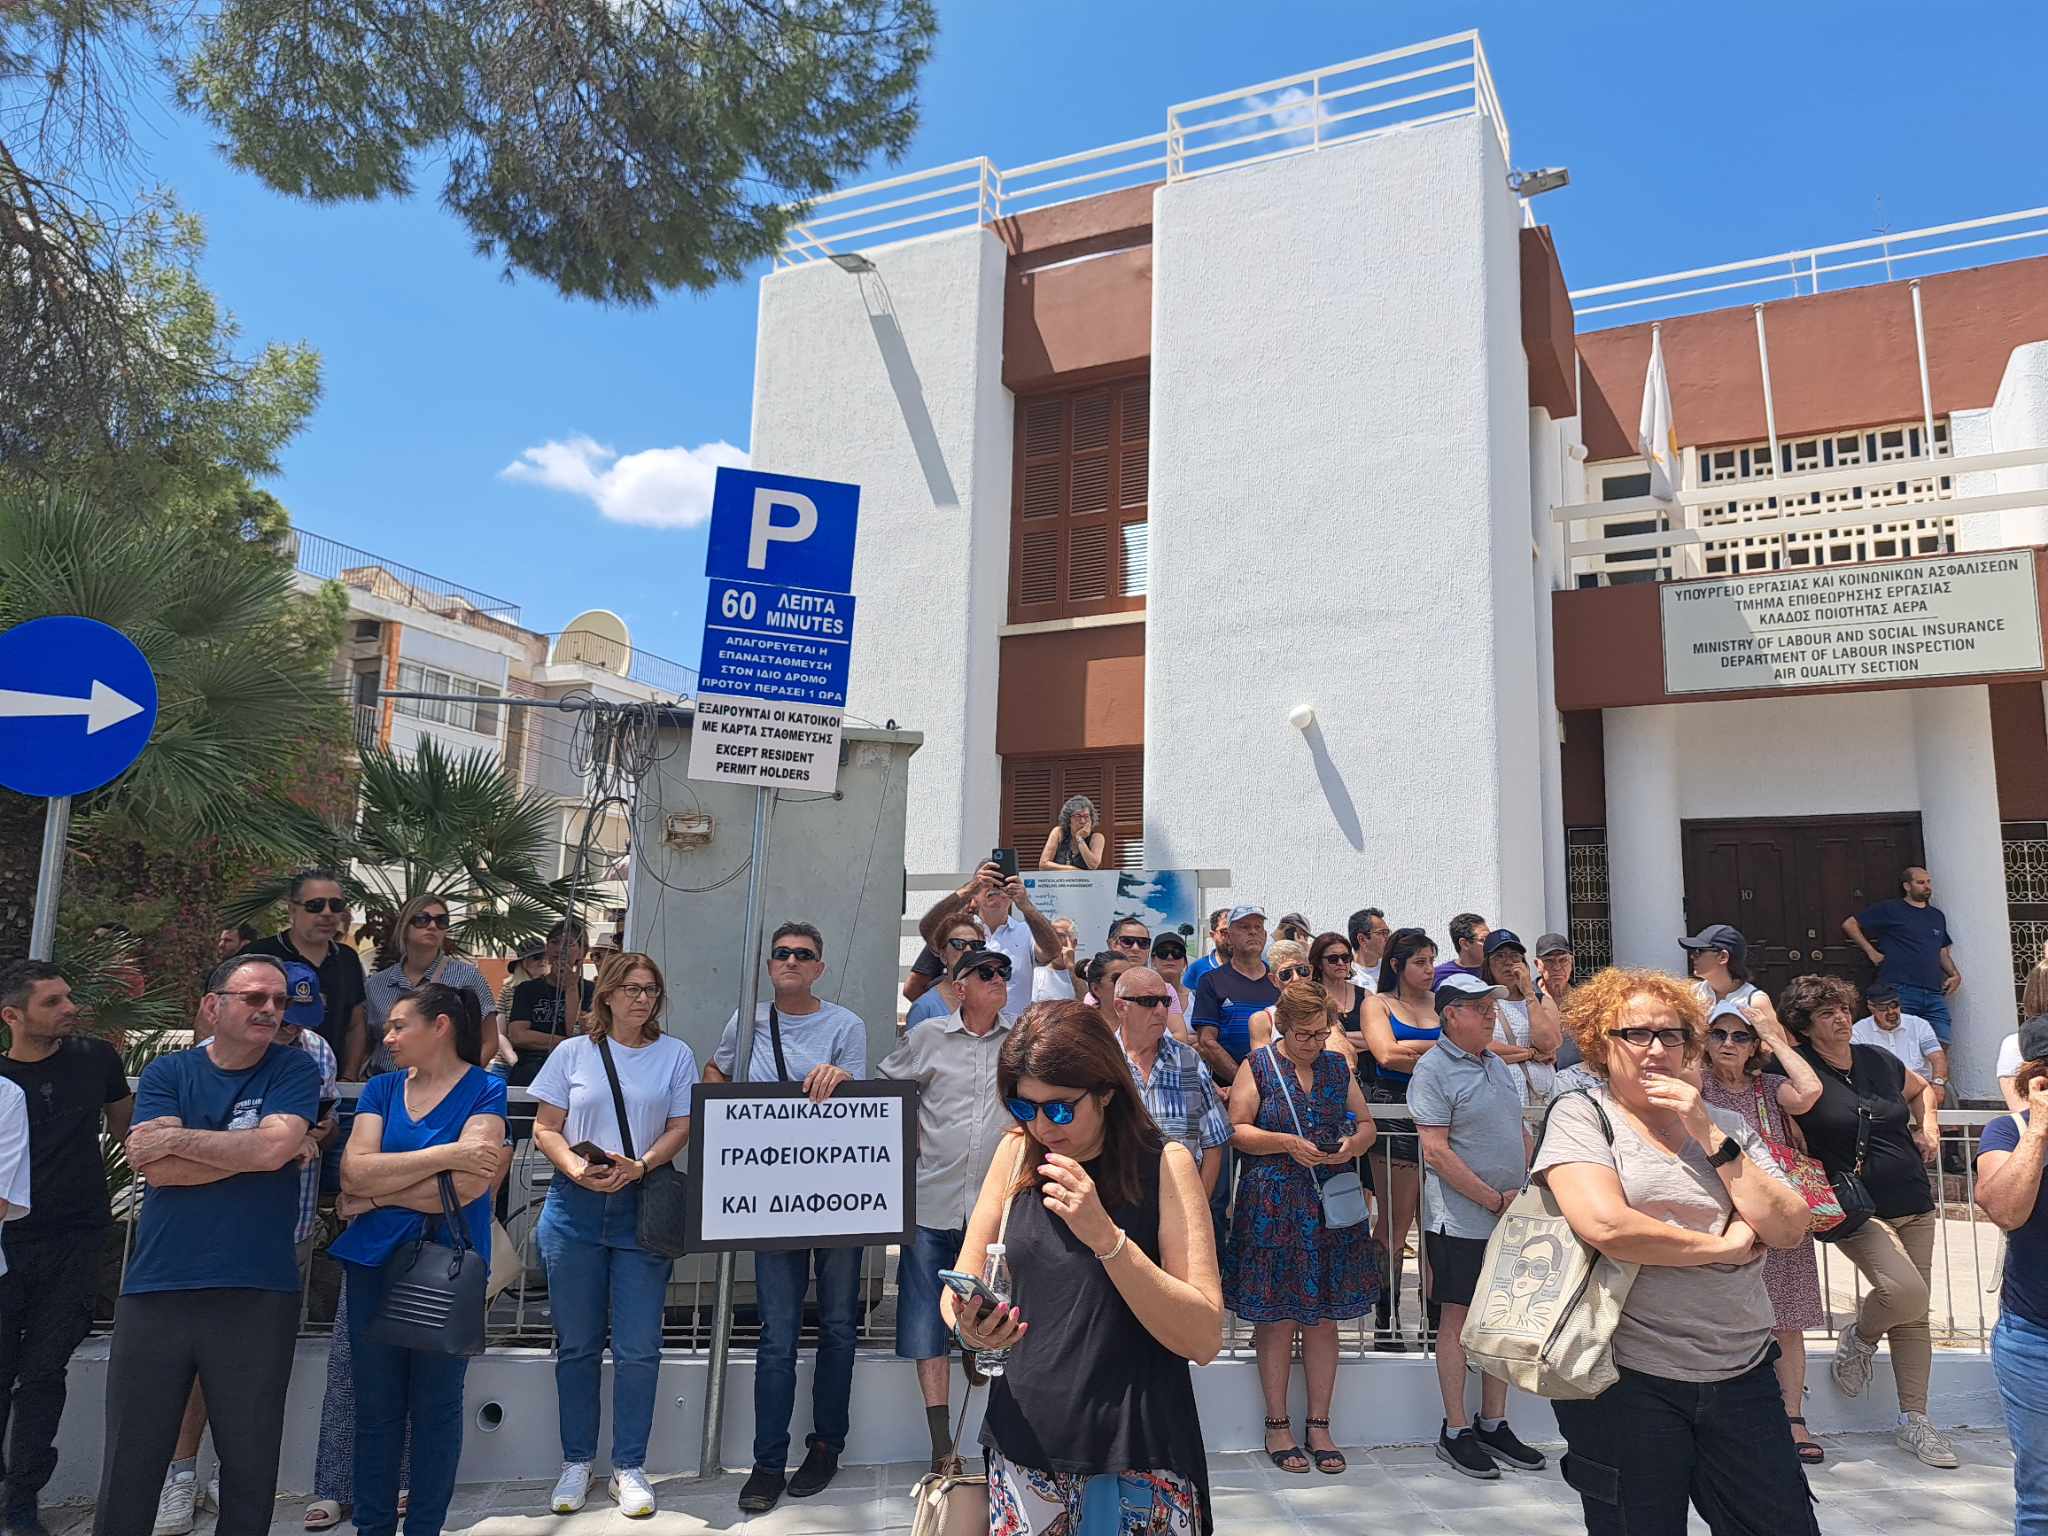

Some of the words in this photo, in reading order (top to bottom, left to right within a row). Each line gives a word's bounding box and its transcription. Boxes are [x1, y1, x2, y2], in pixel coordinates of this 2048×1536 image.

[747, 487, 818, 570] P
[1674, 585, 1744, 601] ΥΠΟΥΡΓΕΙΟ
[1748, 578, 1809, 595] ΕΡΓΑΣΙΑΣ
[1813, 576, 1834, 589] ΚΑΙ
[1840, 568, 1923, 586] ΚΟΙΝΩΝΙΚΩΝ
[1928, 559, 2018, 578] ΑΣΦΑΛΙΣΕΩΝ
[722, 589, 757, 620] 60
[778, 593, 836, 615] ΛΕΠΤΑ
[1735, 598, 1784, 611] ΤΜΗΜΑ
[1789, 588, 1883, 607] ΕΠΙΘΕΩΡΗΣΗΣ
[1887, 581, 1952, 598] ΕΡΓΑΣΙΑΣ
[766, 611, 844, 634] MINUTES
[1760, 610, 1810, 625] ΚΛΑΔΟΣ
[1815, 603, 1888, 620] ΠΟΙΟΤΗΤΑΣ
[1893, 600, 1928, 614] ΑΕΡΑ
[726, 636, 815, 654] ΑΠΑΓΟΡΕΥΕΤΑΙ
[819, 648, 828, 656] Η
[1692, 639, 1753, 654] MINISTRY
[1758, 637, 1774, 649] OF
[1778, 632, 1831, 647] LABOUR
[1836, 630, 1864, 643] AND
[1868, 626, 1918, 640] SOCIAL
[1923, 619, 2005, 636] INSURANCE
[719, 650, 832, 670] ΕΠΑΝΑΣΤΑΘΜΕΥΣΗ
[1721, 651, 1807, 668] DEPARTMENT
[1811, 649, 1829, 661] OF
[1833, 644, 1888, 659] LABOUR
[1892, 637, 1975, 655] INSPECTION
[721, 665, 753, 677] ΣΤΟΝ
[757, 669, 782, 679] ΙΔΙΟ
[785, 672, 827, 685] ΔΡΟΜΟ
[1774, 668, 1796, 680] AIR
[1801, 663, 1856, 679] QUALITY
[1861, 659, 1919, 674] SECTION
[702, 678, 751, 690] ΠΡΟΤΟΥ
[755, 684, 805, 697] ΠΕΡΑΣΕΙ
[810, 690, 815, 698] 1
[819, 690, 842, 701] ΩΡΑ
[698, 702, 770, 720] ΕΞΑΙΡΟΥΝΤΑΙ
[774, 711, 785, 722] ΟΙ
[788, 712, 840, 728] ΚΑΤΟΙΚΟΙ
[702, 720, 718, 732] ΜΕ
[721, 722, 757, 737] ΚΑΡΤΑ
[760, 727, 833, 744] ΣΤΑΘΜΕΥΣΗΣ
[716, 744, 759, 758] EXCEPT
[761, 748, 814, 764] RESIDENT
[716, 761, 757, 776] PERMIT
[760, 766, 810, 781] HOLDERS
[726, 1102, 889, 1120] ΚΑΤΑΔΙΚΑΖΟΥΜΕ
[721, 1145, 891, 1166] ΓΡΑΦΕΙΟΚΡΑΤΙΑ
[722, 1196, 757, 1214] ΚΑΙ
[769, 1192, 887, 1213] ΔΙΑΦΘΟΡΑ
